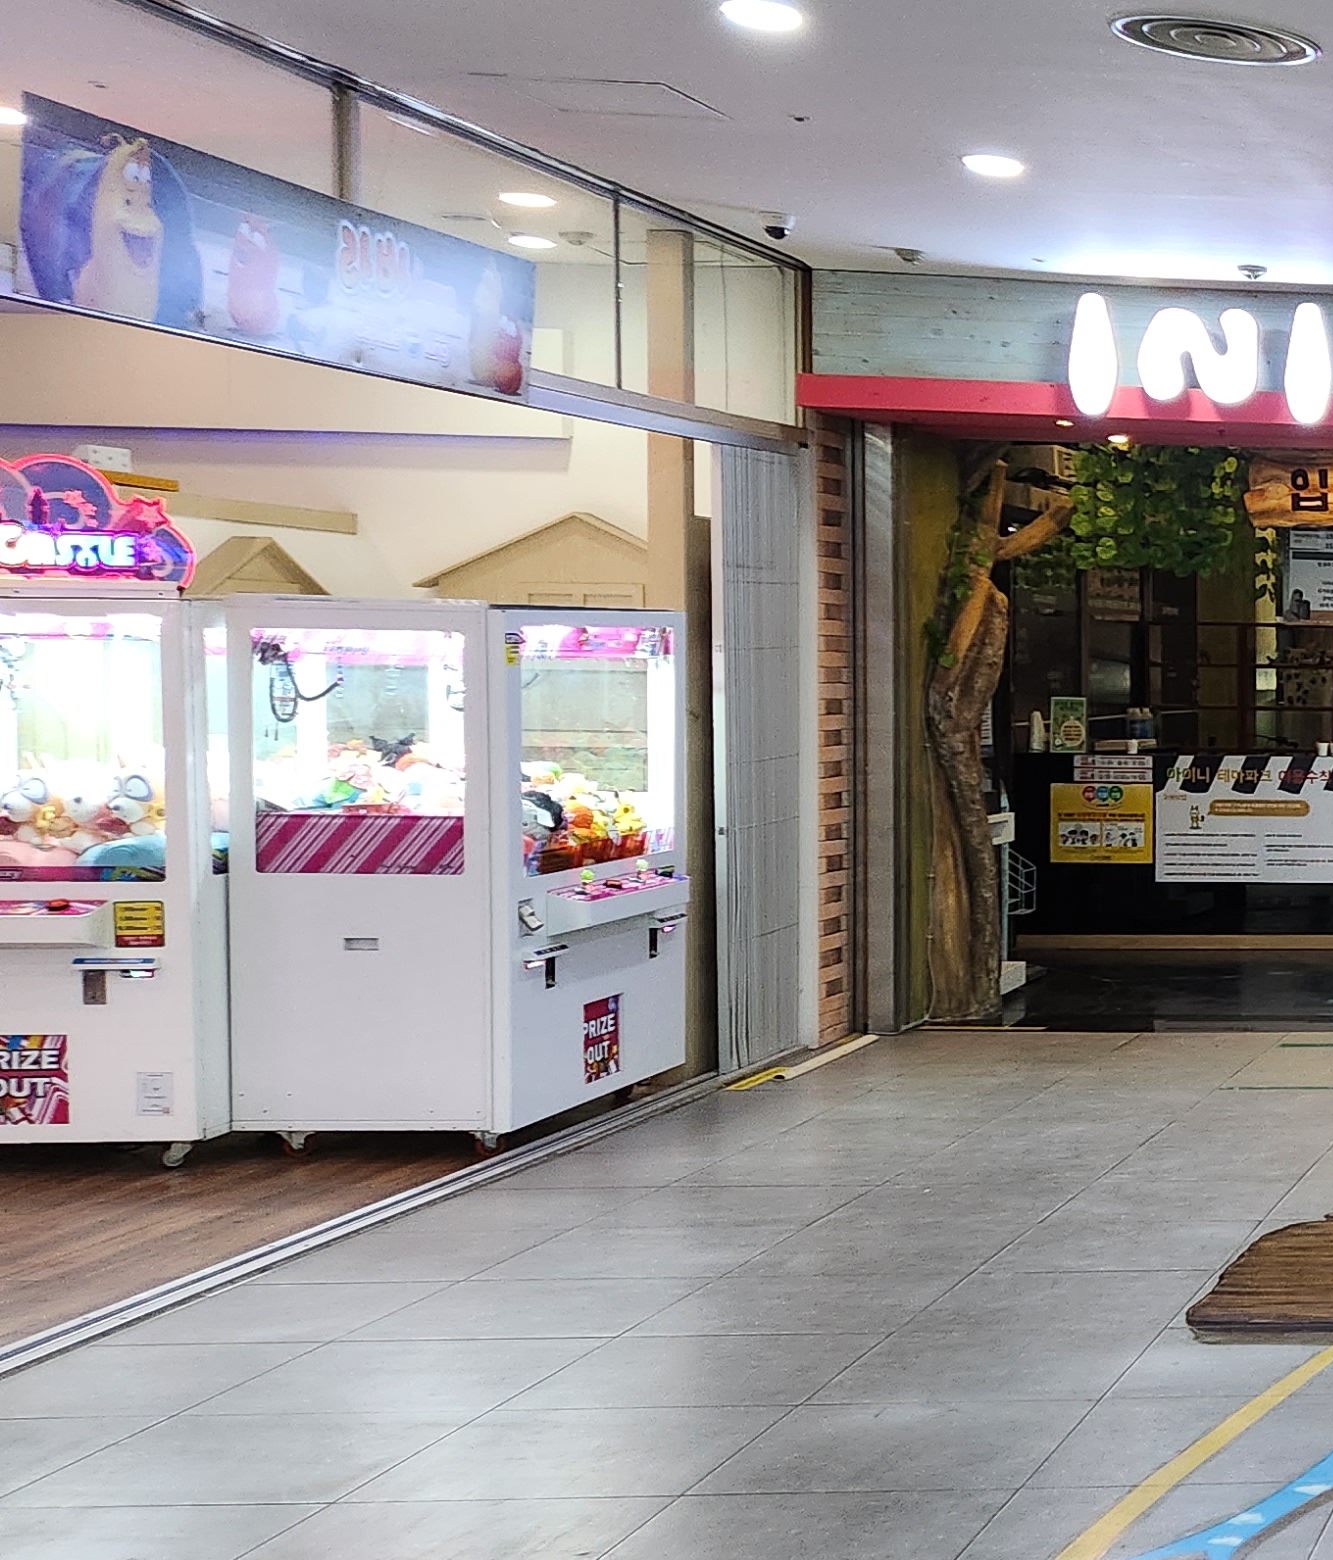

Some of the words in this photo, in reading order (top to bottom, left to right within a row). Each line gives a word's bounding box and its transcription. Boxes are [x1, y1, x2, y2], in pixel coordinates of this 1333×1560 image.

[1068, 292, 1332, 425] INI
[1166, 766, 1211, 783] 아이니
[1216, 767, 1273, 783] 테마파크
[587, 1040, 610, 1065] OUT
